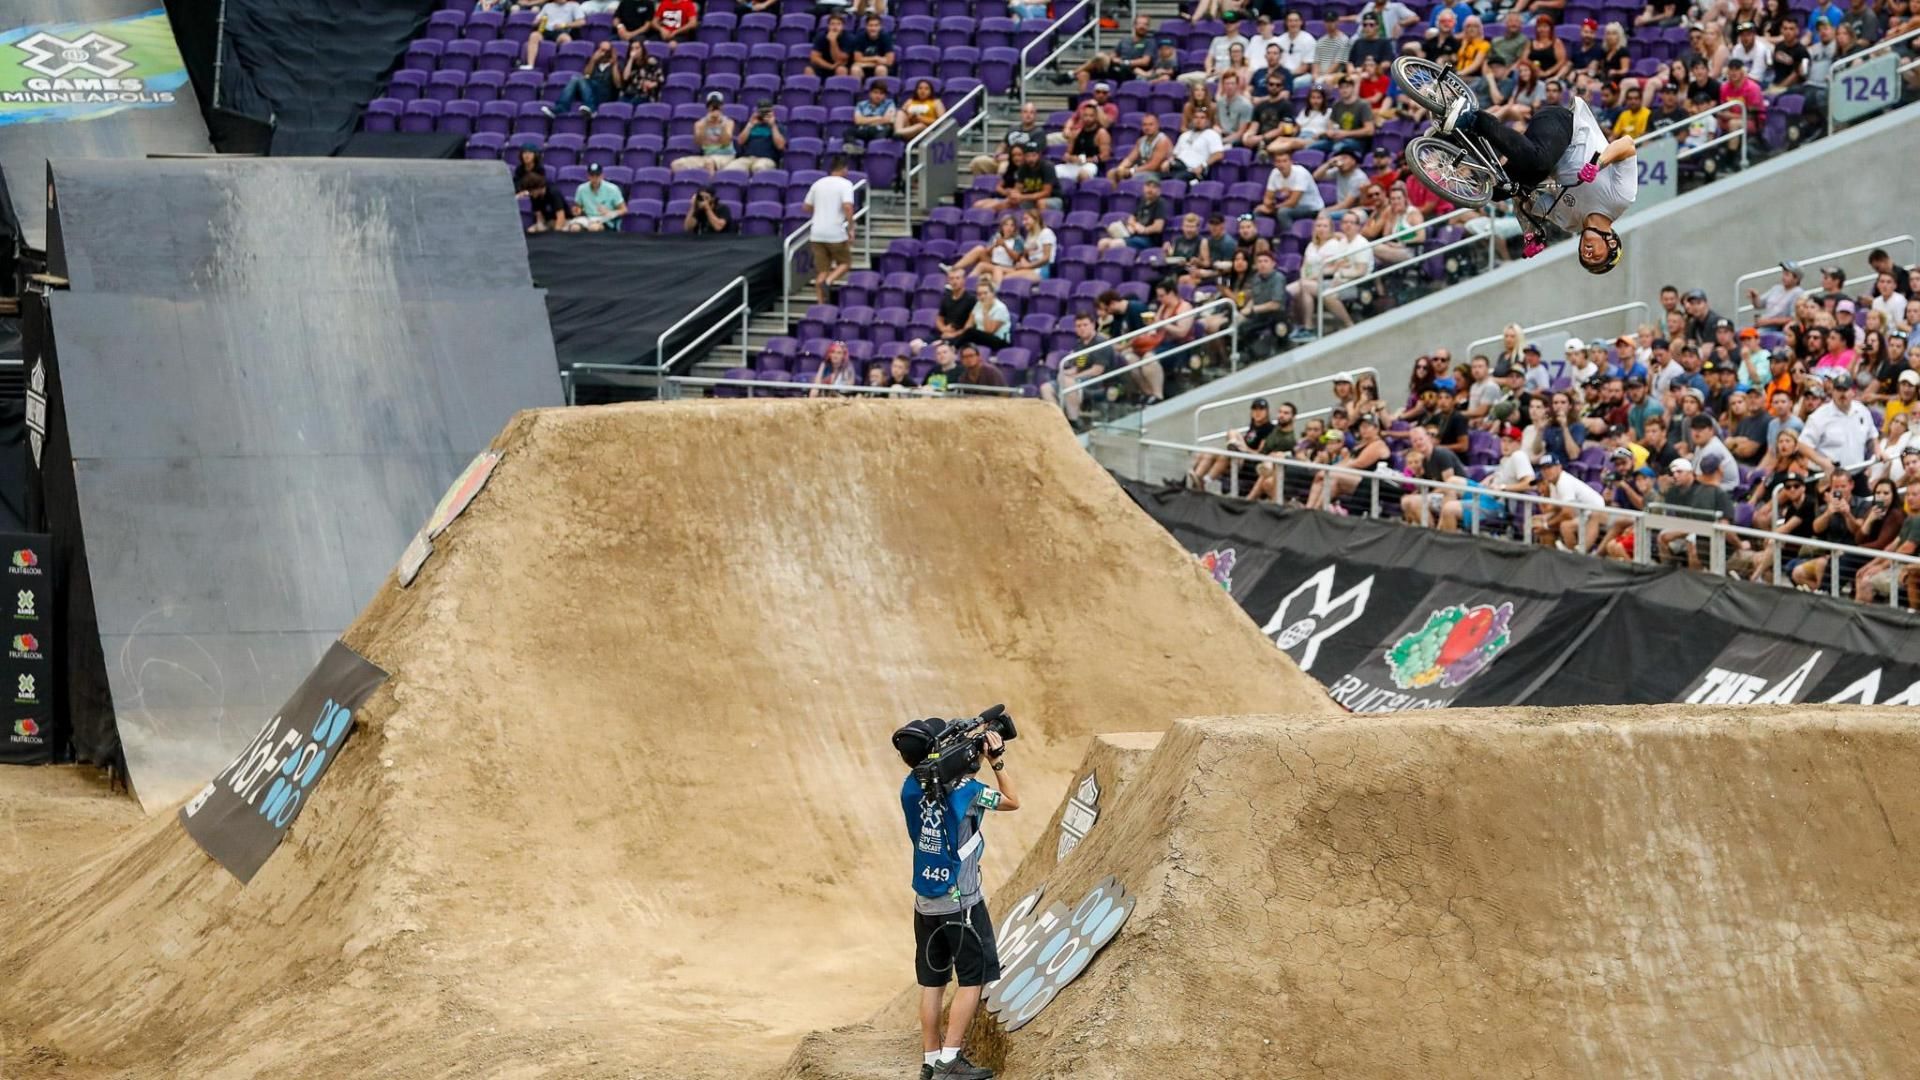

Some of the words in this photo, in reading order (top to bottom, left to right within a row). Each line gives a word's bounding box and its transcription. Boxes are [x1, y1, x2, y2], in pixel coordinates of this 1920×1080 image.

[27, 78, 143, 91] GAMES
[1841, 76, 1889, 101] 124
[3, 91, 176, 103] MINNEAPOLIS
[1636, 160, 1668, 185] 24
[922, 866, 950, 881] 449
